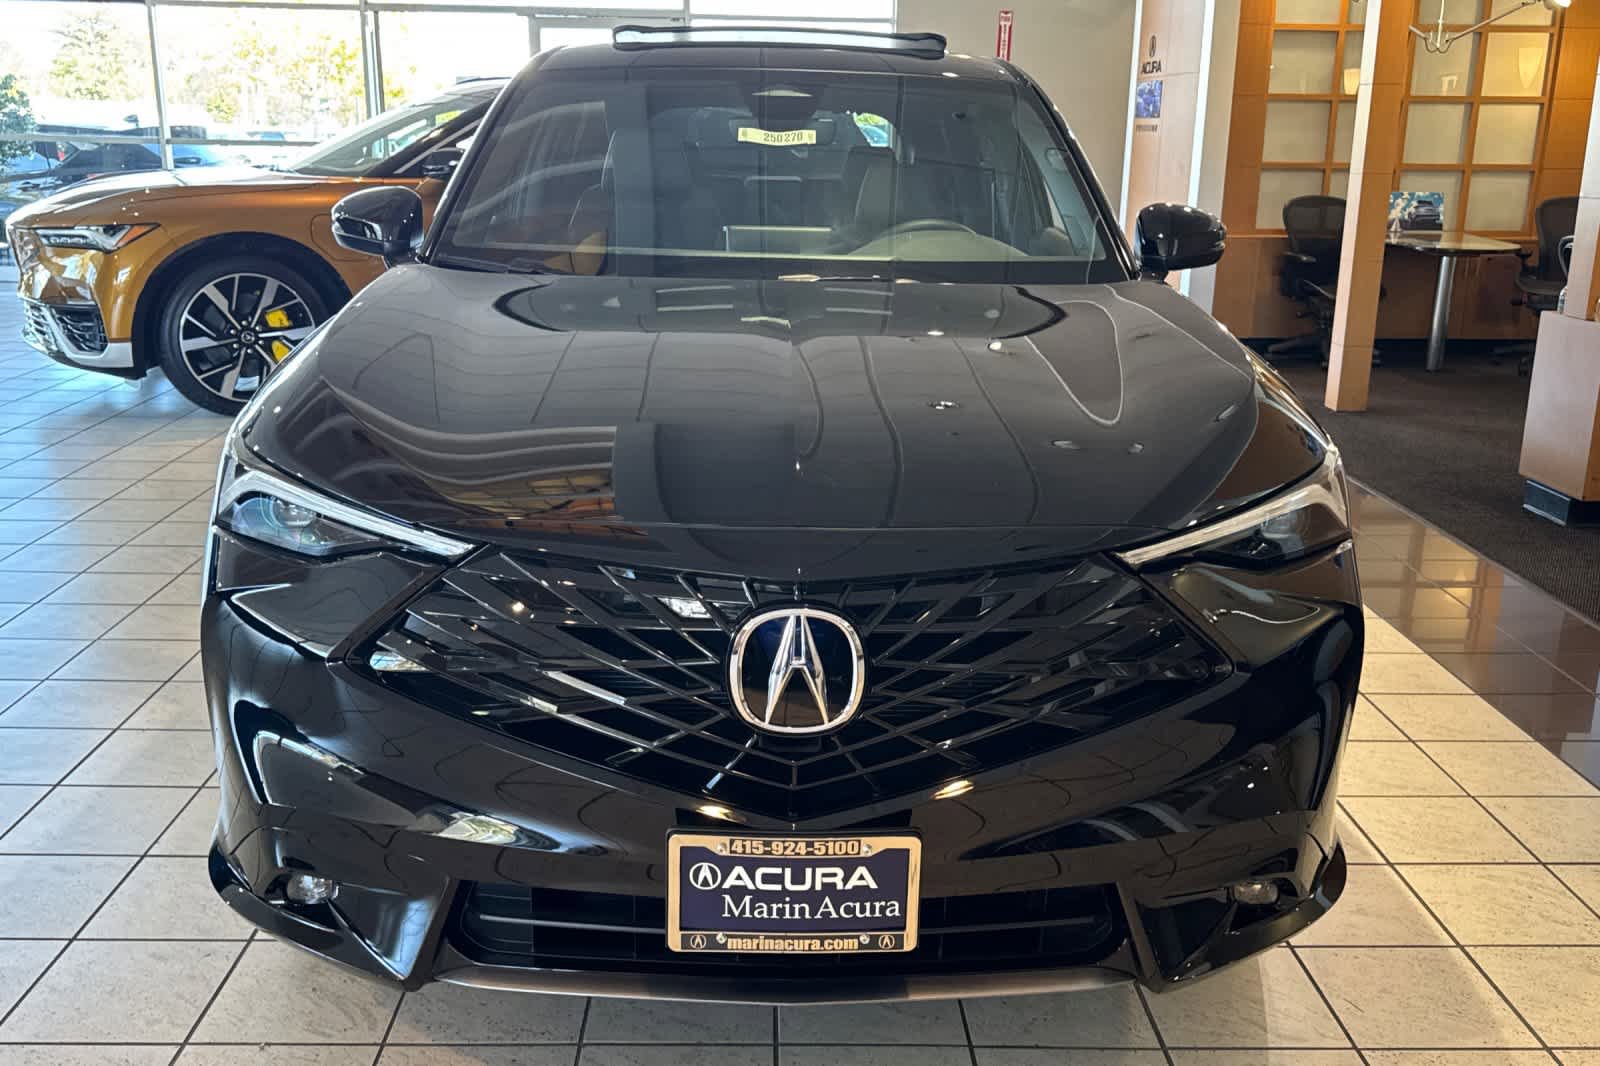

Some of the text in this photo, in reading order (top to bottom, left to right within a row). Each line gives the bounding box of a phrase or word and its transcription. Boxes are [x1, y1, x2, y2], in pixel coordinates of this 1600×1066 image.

[731, 839, 859, 856] 415-924-5100
[722, 866, 878, 890] ACURA
[721, 894, 901, 919] Marin Acura
[727, 936, 859, 951] marinacura.com
